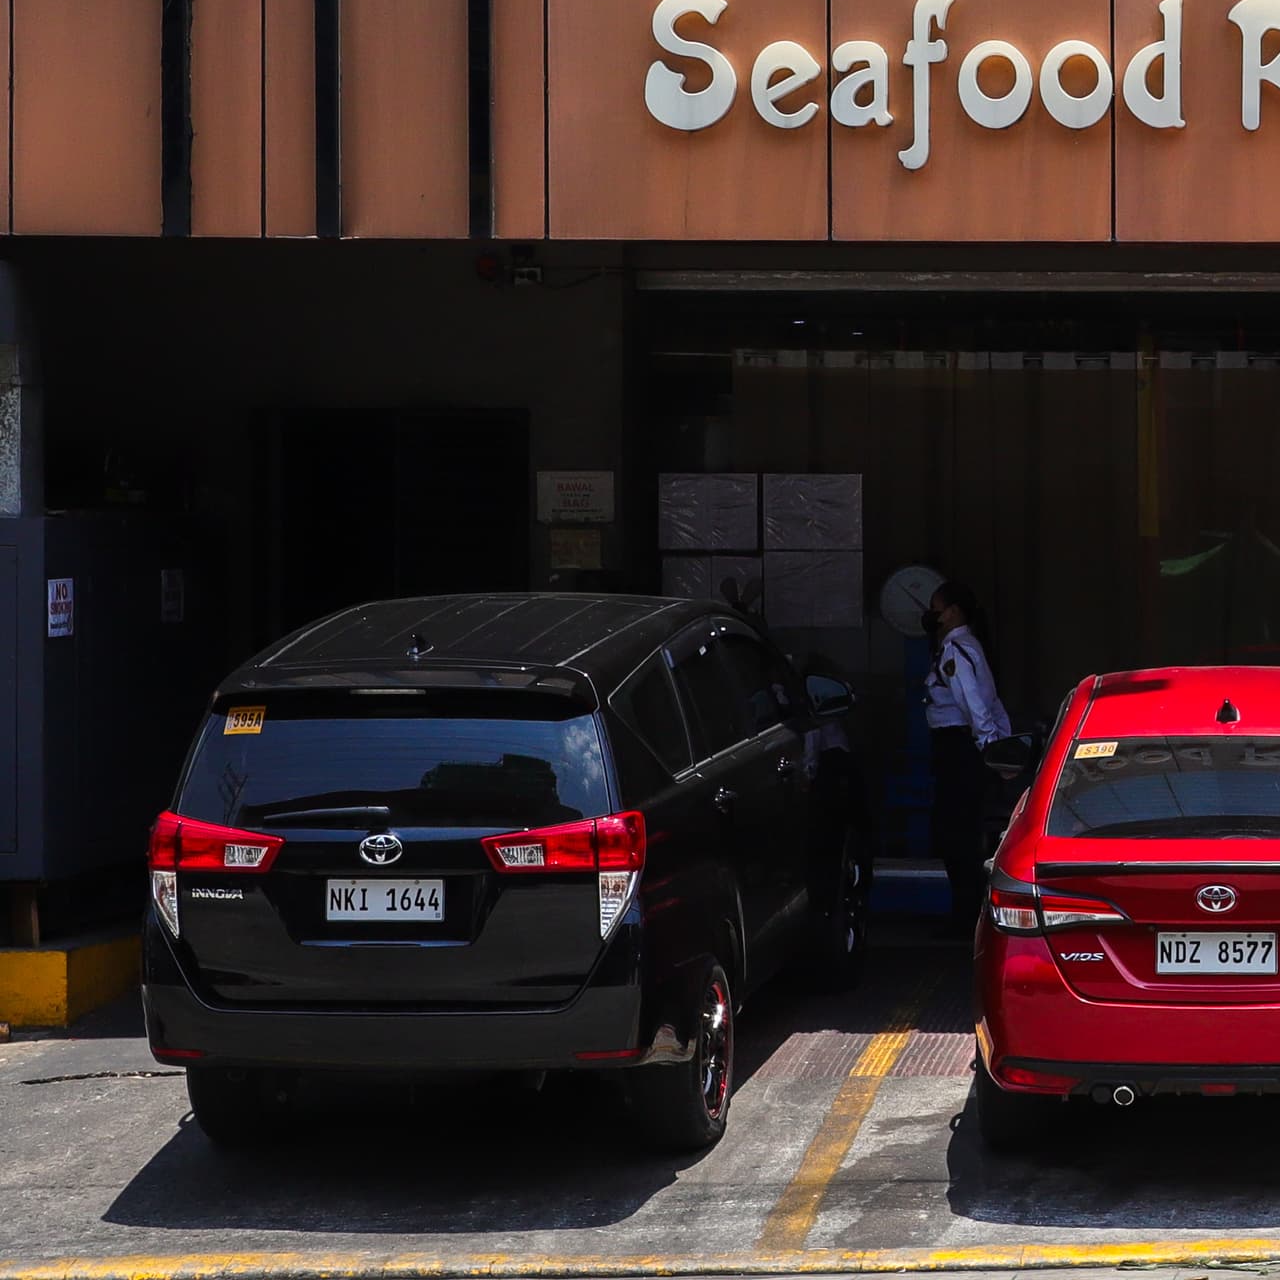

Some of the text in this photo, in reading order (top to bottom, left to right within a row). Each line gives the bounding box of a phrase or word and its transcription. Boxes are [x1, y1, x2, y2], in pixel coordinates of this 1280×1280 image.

[55, 583, 68, 601] NO
[233, 712, 261, 728] 595A
[191, 888, 244, 900] INNOVA
[330, 888, 440, 911] NKI 1644
[1060, 952, 1105, 962] VIOS
[1160, 941, 1273, 964] NDZ 8577
